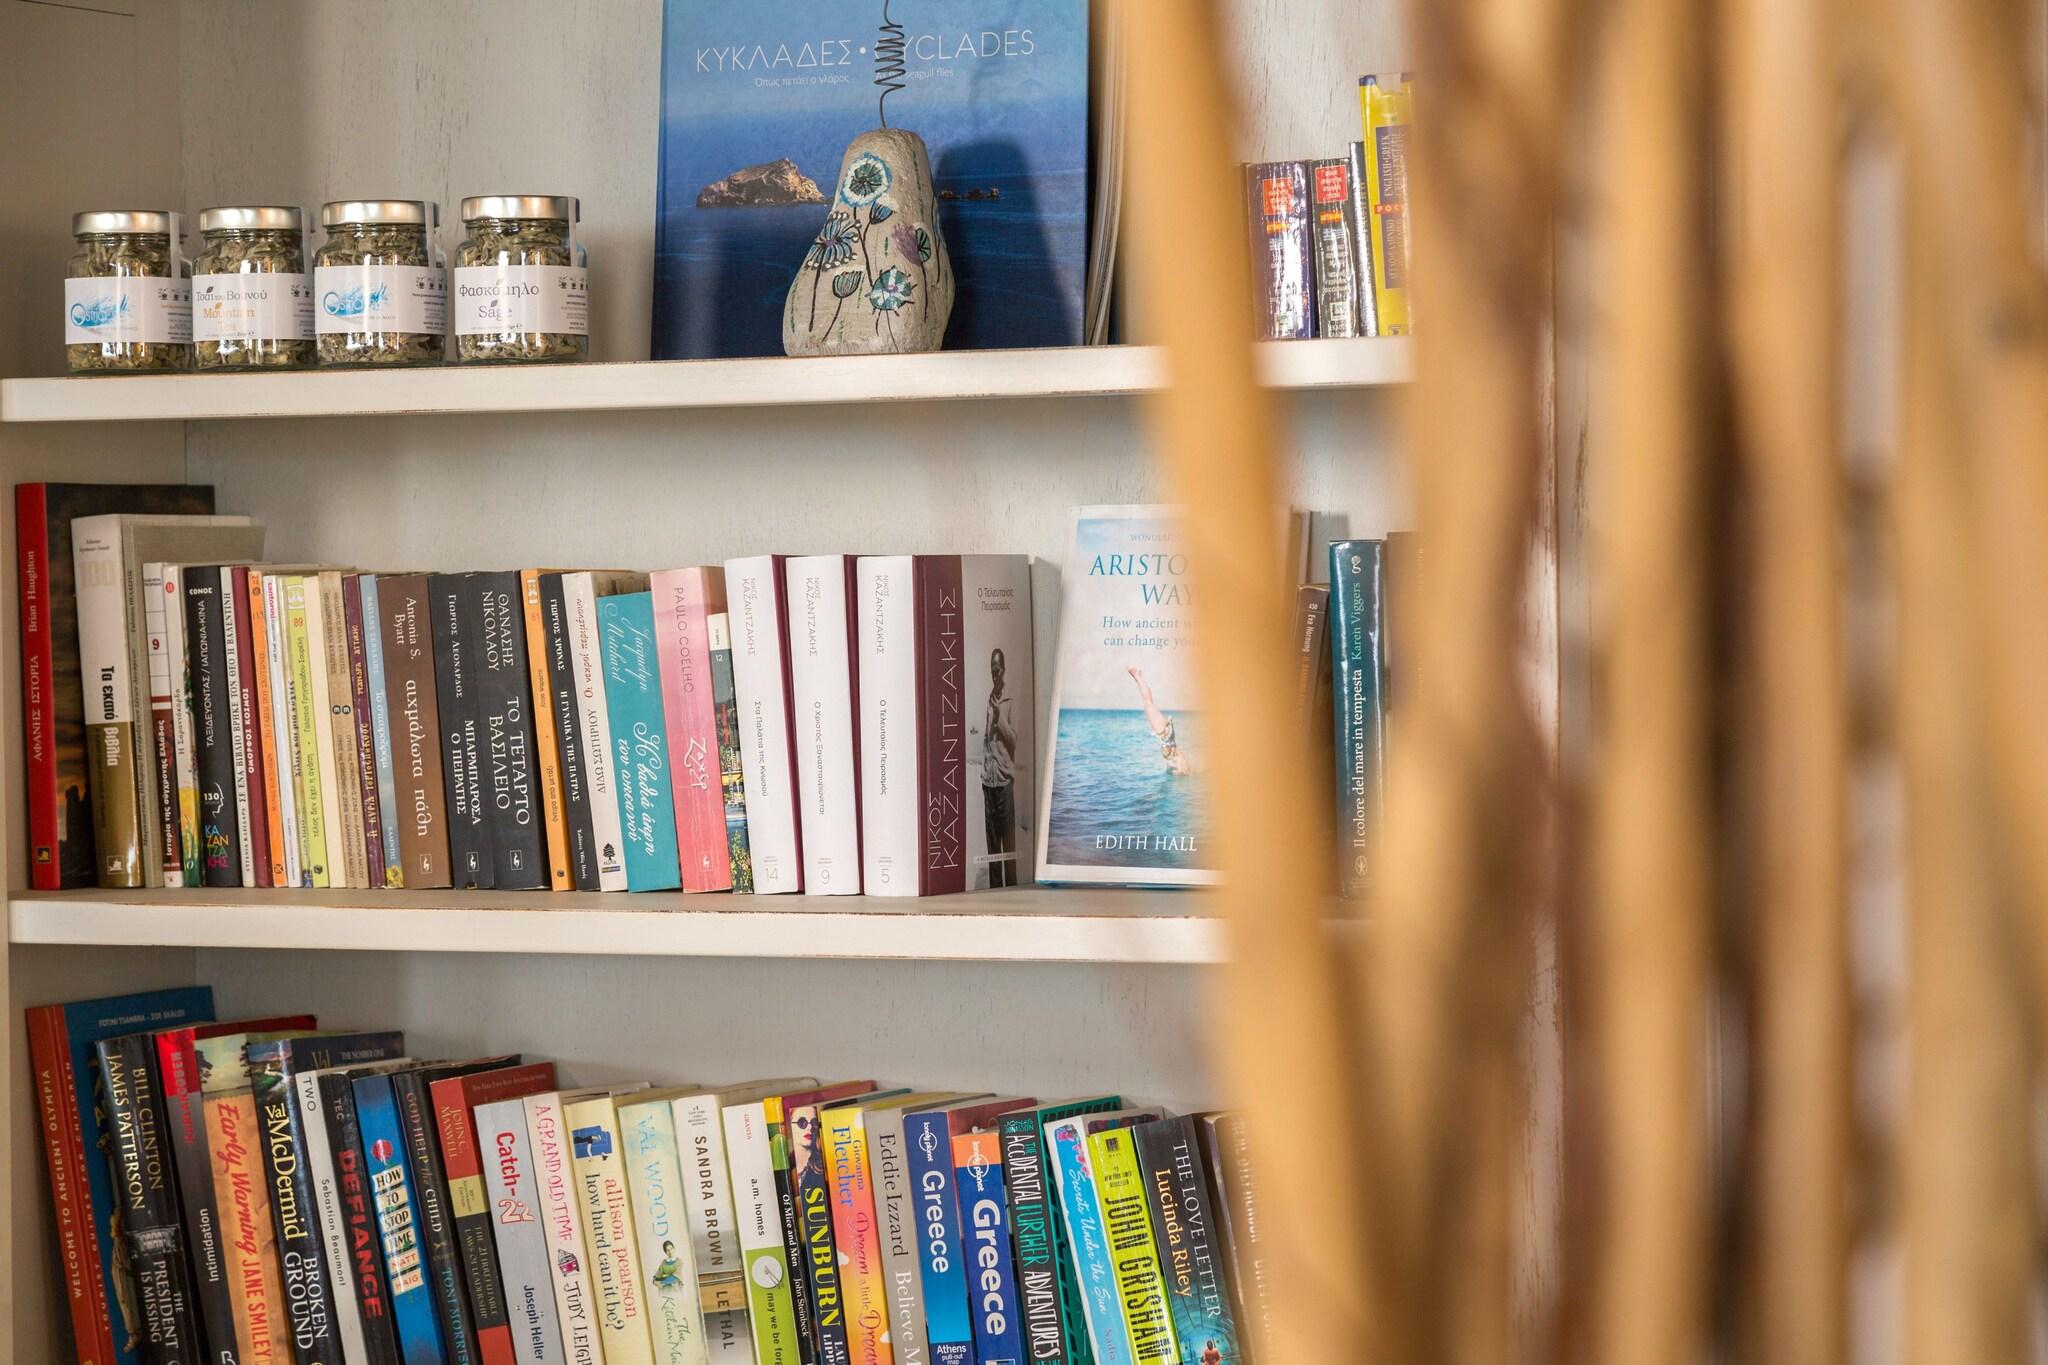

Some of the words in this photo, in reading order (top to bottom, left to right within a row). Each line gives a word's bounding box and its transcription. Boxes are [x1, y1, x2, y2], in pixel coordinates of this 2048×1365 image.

[696, 40, 852, 72] ΚΥΚΛΑΔΕΣ
[26, 550, 36, 600] Haughton
[27, 604, 38, 633] Brian
[223, 592, 234, 645] ΒΑΛΕΝΤΙΝΗ
[406, 597, 419, 645] Antonia
[674, 587, 688, 631] PAULO
[742, 578, 756, 656] ΚΑΖΑΝΤΖΑΚΗΣ
[805, 577, 818, 656] ΚΑΖΑΝΤΖΑΚΗΣ
[875, 575, 885, 656] ΚΑΖΑΝΤΖΑΚΗΣ
[1103, 616, 1131, 628] How
[1136, 617, 1178, 629] ancient
[1350, 582, 1365, 624] Viggers
[197, 600, 209, 668] ΙΑΠΩΝΙΑ-ΚΙΝΑ
[393, 614, 406, 645] Byatt
[410, 648, 422, 660] S.
[482, 591, 500, 671] ΝΙΚΟΛΑΟΥ
[498, 593, 514, 667] ΘΑΝΑΣΗΣ
[605, 603, 627, 684] Mitchard
[621, 616, 652, 691] Jacquelyn
[1103, 637, 1124, 646] can
[1128, 634, 1169, 648] change
[1351, 627, 1362, 660] Karen
[29, 655, 41, 707] ΙΣΤΟΡΙΑ
[101, 666, 115, 682] Τα
[227, 656, 236, 677] ΘΕΟ
[678, 636, 695, 693] COELHO
[102, 685, 116, 721] εκατό
[203, 675, 214, 748] ΤΑΞΙΔΕΥΟΝΤΑΣ
[228, 680, 238, 699] ΤΟΝ
[507, 696, 521, 722] ΤΟ
[1351, 669, 1366, 725] tempesta
[31, 708, 43, 762] ΑΦΑΝΗΣ
[231, 701, 241, 732] ΒΡΗΚΕ
[451, 733, 461, 744] Ο
[756, 717, 765, 748] Παλάτια
[939, 588, 960, 869] ΚΑΖΑΝΤΖΑΚΗΣ
[1351, 727, 1362, 741] in
[233, 734, 243, 767] ΒΙΒΛΙΟ
[404, 680, 426, 778] αιχμάλωτα
[415, 789, 432, 837] πάθη
[465, 720, 482, 825] ΜΠΑΡΜΠΑΡΟΣΑ
[489, 715, 511, 810] ΒΑΣΙΛΕΙΟ
[617, 739, 630, 767] του
[758, 750, 766, 764] της
[1352, 742, 1364, 774] mare
[236, 768, 245, 789] ΕΝΑ
[452, 750, 467, 815] ΠΕΙΡΑΤΗΣ
[510, 731, 530, 825] ΤΕΤΑΡΤΟ
[759, 765, 768, 796] Κνωσού
[1351, 775, 1364, 796] del
[929, 792, 942, 870] ΝΙΚΟΣ
[1352, 798, 1365, 837] colore
[1096, 834, 1148, 849] EDITH
[1155, 836, 1198, 851] HALL
[41, 1069, 58, 1131] OLYMPIA
[106, 1054, 130, 1107] JAMES
[132, 1067, 149, 1104] BILL
[304, 1076, 316, 1112] TWO
[264, 1101, 286, 1120] Val
[405, 1091, 422, 1124] GOD
[535, 1104, 552, 1116] A
[924, 1121, 932, 1142] lonely
[139, 1107, 164, 1190] CLINTON
[217, 1103, 248, 1174] Early
[413, 1127, 431, 1163] HELP
[441, 1106, 457, 1161] MAXWELL
[537, 1118, 561, 1179] GRAND
[636, 1114, 657, 1156] VAL
[925, 1142, 934, 1162] planet
[971, 1140, 982, 1166] lonely
[51, 1138, 68, 1201] ANCIENT
[116, 1112, 146, 1210] PATTERSON
[266, 1116, 308, 1241] McDermid
[376, 1167, 402, 1187] HOW
[832, 1126, 855, 1207] Fletcher
[852, 1139, 864, 1191] Giovanna
[878, 1132, 902, 1189] Eddie
[974, 1165, 986, 1192] planet
[1005, 1134, 1043, 1204] ACCIDENTAL
[1173, 1139, 1194, 1182] THE
[232, 1171, 260, 1256] Warning
[386, 1191, 400, 1206] TO
[424, 1189, 442, 1234] CHILD
[546, 1178, 565, 1202] OLD
[605, 1178, 626, 1241] allison
[643, 1160, 669, 1238] WOOD
[694, 1135, 715, 1202] SANDRA
[705, 1208, 724, 1267] BROWN
[750, 1177, 760, 1202] a.m.
[755, 1202, 765, 1237] homes
[782, 1193, 790, 1204] Of
[1182, 1183, 1206, 1241] LOVE
[61, 1207, 72, 1225] TO
[321, 1178, 336, 1231] Sebastian
[331, 1233, 347, 1287] Beaumont
[338, 1149, 382, 1319] DEFIANCE
[384, 1210, 410, 1229] STOP
[388, 1230, 414, 1248] TIME
[550, 1201, 574, 1242] TIME
[783, 1205, 793, 1228] Mice
[786, 1228, 796, 1245] and
[886, 1192, 909, 1258] Izzard
[922, 1170, 950, 1274] Greece
[1014, 1204, 1051, 1266] FURTHER
[1105, 1194, 1150, 1252] JOHN
[1155, 1168, 1184, 1246] Lucinda
[1172, 1248, 1193, 1299] Riley
[65, 1230, 83, 1299] WELCOME
[200, 1208, 219, 1282] Intimidation
[389, 1253, 416, 1270] MATT
[788, 1246, 798, 1268] Men
[803, 1186, 841, 1329] SUNBURN
[973, 1198, 1007, 1336] Greece
[141, 1271, 151, 1284] IS
[173, 1291, 184, 1313] THE
[242, 1259, 265, 1296] JANE
[285, 1252, 314, 1350] GROUND
[304, 1256, 329, 1339] BROKEN
[394, 1273, 419, 1291] HAIG
[612, 1246, 637, 1318] pearson
[793, 1277, 802, 1295] John
[1193, 1242, 1222, 1320] LETTER
[143, 1287, 162, 1344] MISSING
[153, 1260, 180, 1349] PRESIDENT
[524, 1284, 538, 1325] Joseph
[715, 1290, 736, 1350] LETHAL
[795, 1296, 809, 1337] Steinbeck
[895, 1271, 915, 1342] Believe
[1024, 1271, 1062, 1358] ADVENTURES
[1119, 1255, 1172, 1362] GRISHAM
[247, 1303, 272, 1360] SMILEY
[530, 1325, 545, 1361] Heller
[936, 1343, 967, 1354] Athens
[941, 1353, 963, 1362] pull-out
